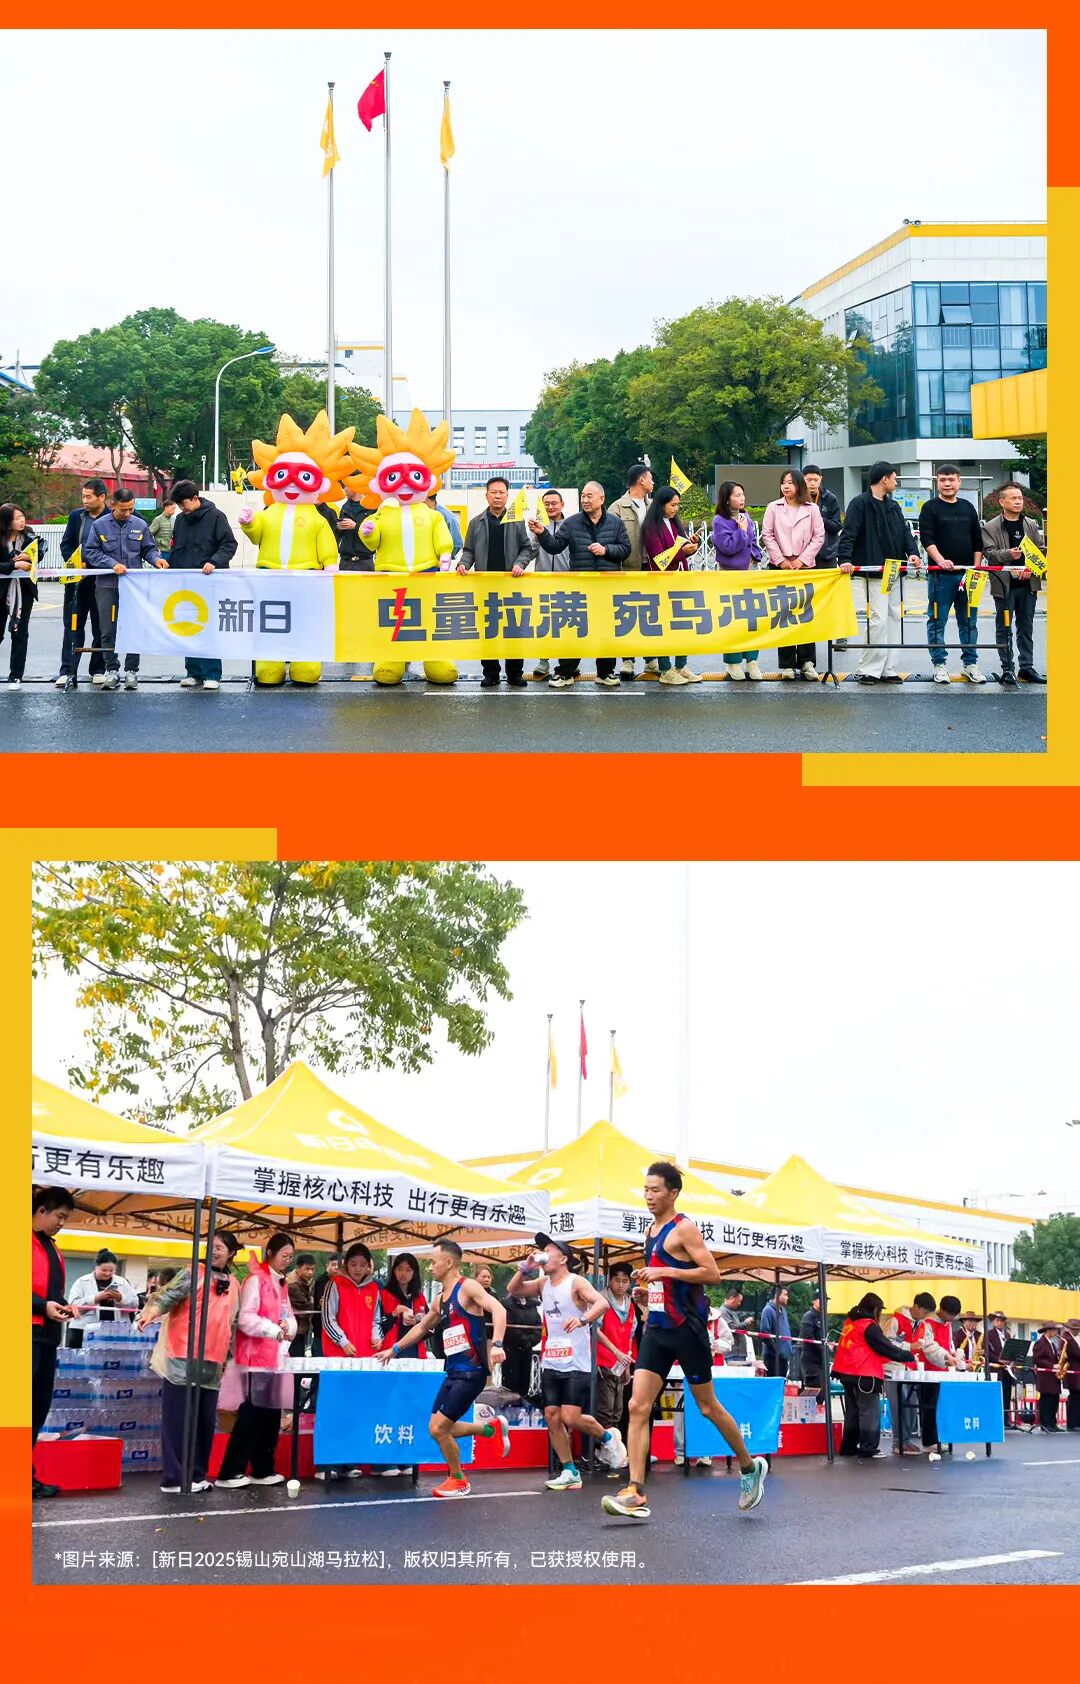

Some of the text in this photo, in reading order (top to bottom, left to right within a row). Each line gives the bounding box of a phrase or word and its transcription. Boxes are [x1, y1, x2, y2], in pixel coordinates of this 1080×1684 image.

[218, 598, 292, 634] 新日
[378, 582, 817, 642] 电量拉满 宛马冲刺
[253, 1166, 527, 1227] 掌握核心科技 出行更有乐趣
[723, 1223, 805, 1253] 出行更有乐趣
[840, 1240, 975, 1273] 掌握核心科技 出行更有乐趣
[375, 1423, 414, 1445] 饮料
